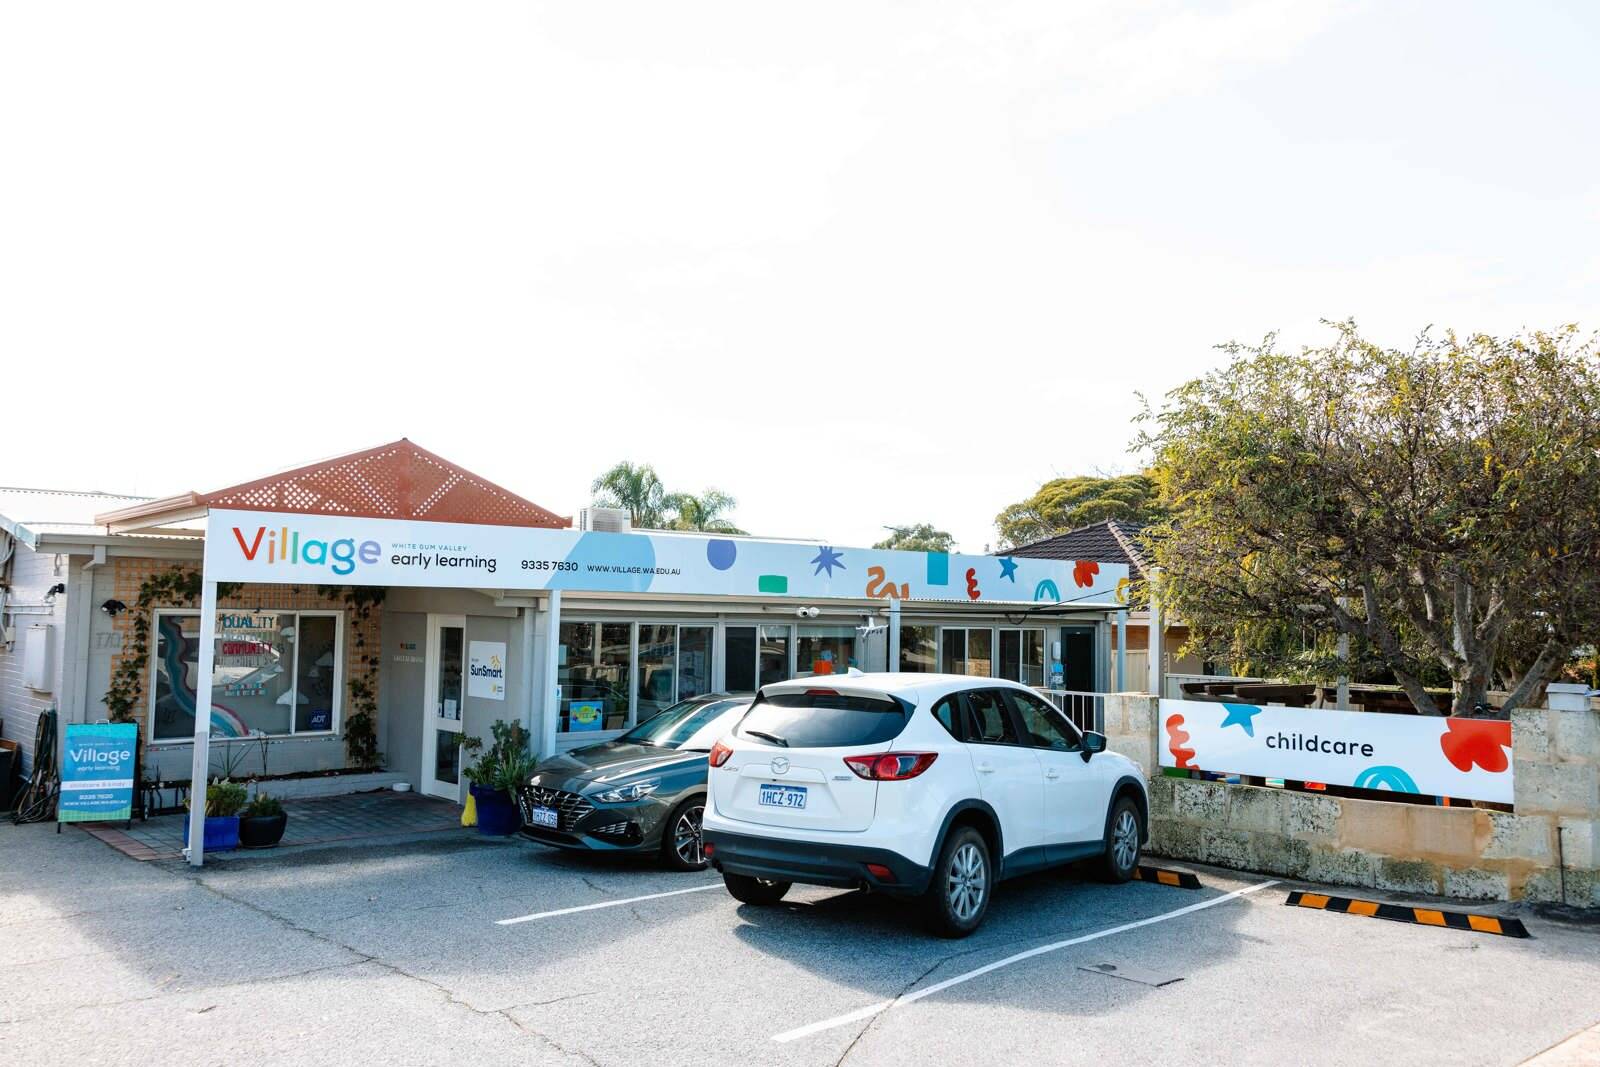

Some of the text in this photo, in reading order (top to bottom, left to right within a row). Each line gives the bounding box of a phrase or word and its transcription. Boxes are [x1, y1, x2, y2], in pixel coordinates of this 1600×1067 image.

[232, 526, 381, 575] Village
[391, 552, 497, 573] early learning
[521, 560, 578, 572] 9335 7630
[587, 564, 681, 575] WWW.VILLAGE.WA.EDU.AU
[223, 614, 274, 628] QUALITY
[470, 664, 502, 678] SunSmart
[1266, 732, 1374, 757] childcare
[69, 747, 131, 765] Village
[762, 790, 804, 807] 1HCZ 972
